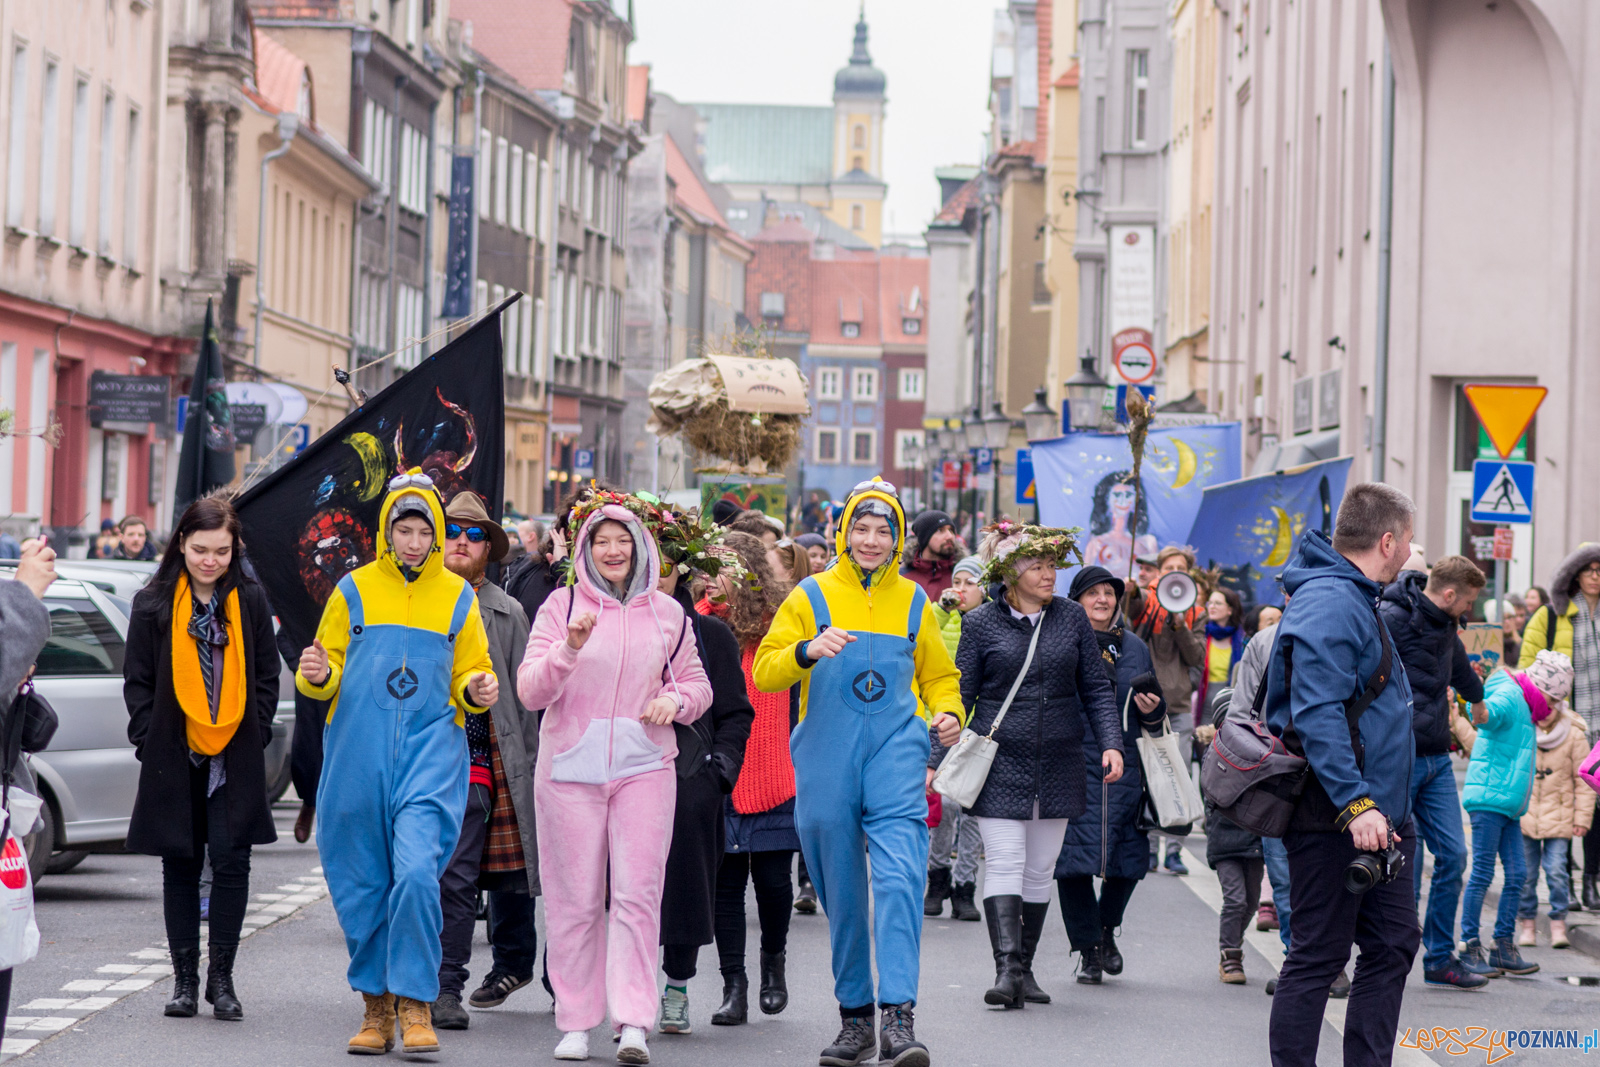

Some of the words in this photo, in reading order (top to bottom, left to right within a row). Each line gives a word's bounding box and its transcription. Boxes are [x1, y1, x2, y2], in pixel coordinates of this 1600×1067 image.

[95, 382, 121, 391] AKTY
[124, 383, 166, 393] ZGONU
[578, 451, 590, 466] P
